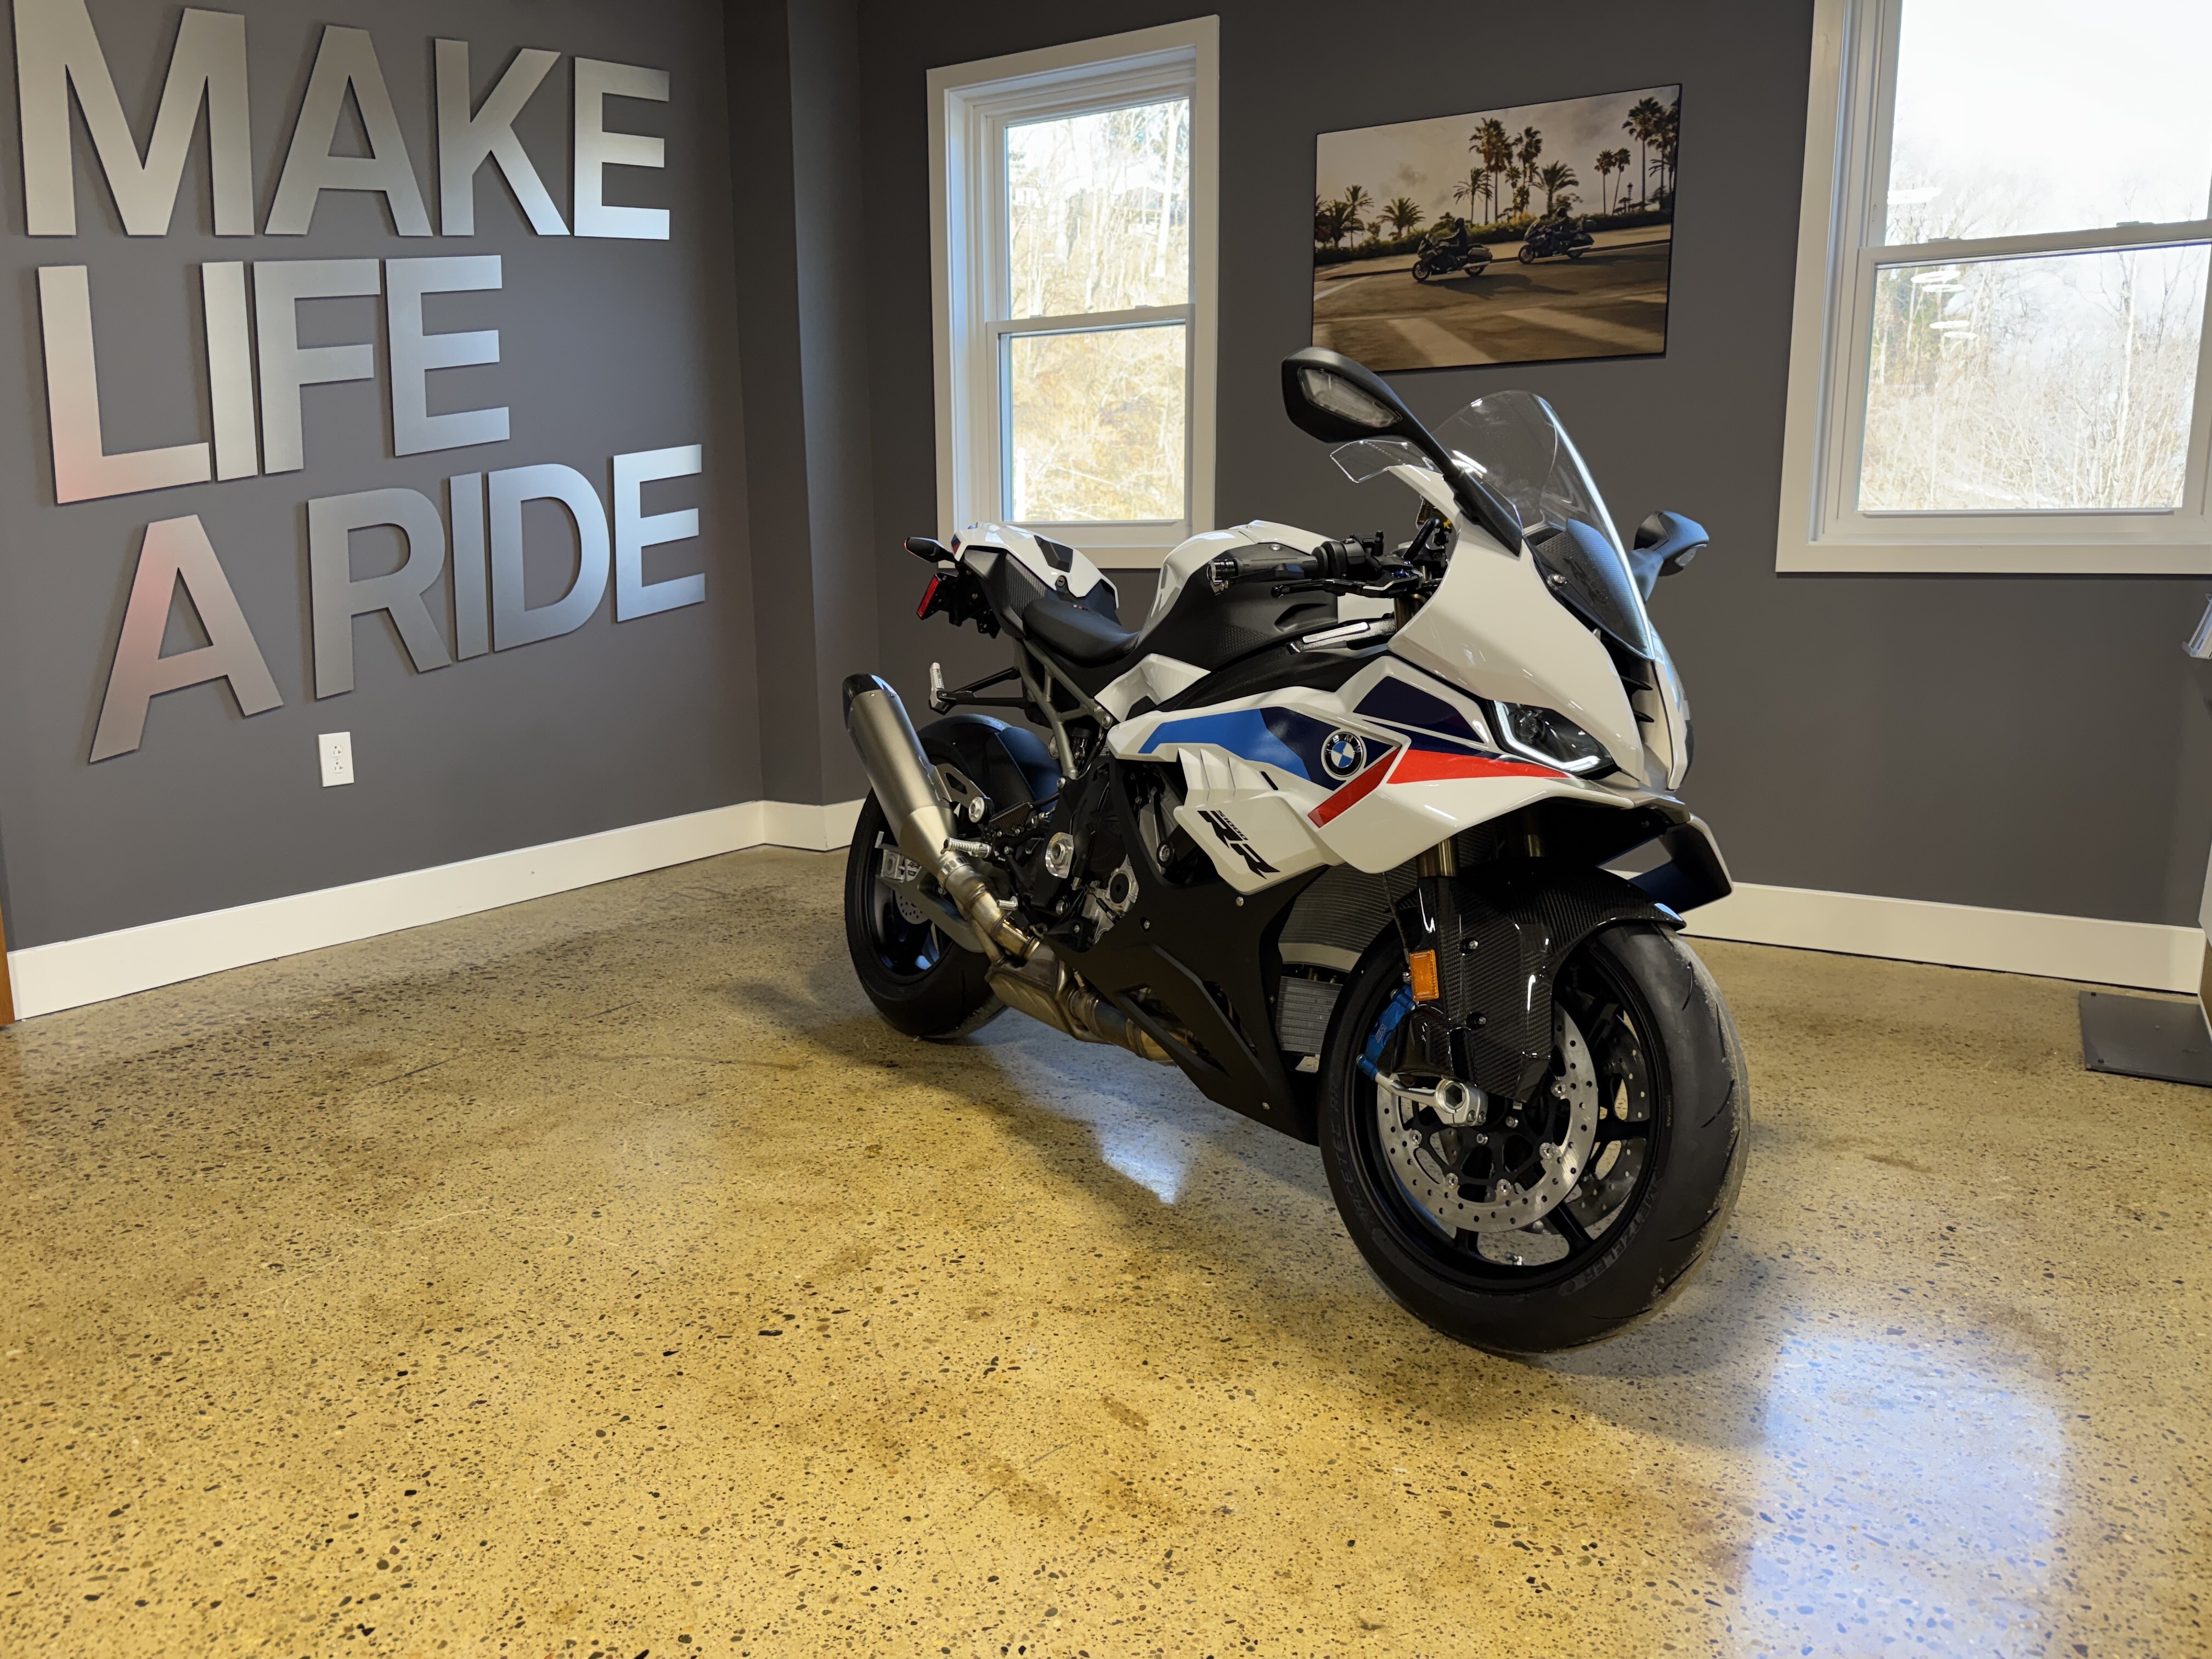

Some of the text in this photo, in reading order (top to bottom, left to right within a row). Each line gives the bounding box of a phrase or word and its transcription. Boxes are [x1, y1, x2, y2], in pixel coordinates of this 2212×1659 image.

[13, 0, 670, 240] MAKE
[38, 255, 510, 505] LIFE
[89, 444, 706, 764] A RIDE
[1333, 734, 1362, 753] BMW
[1197, 810, 1281, 880] RR
[1216, 810, 1249, 840] S1000
